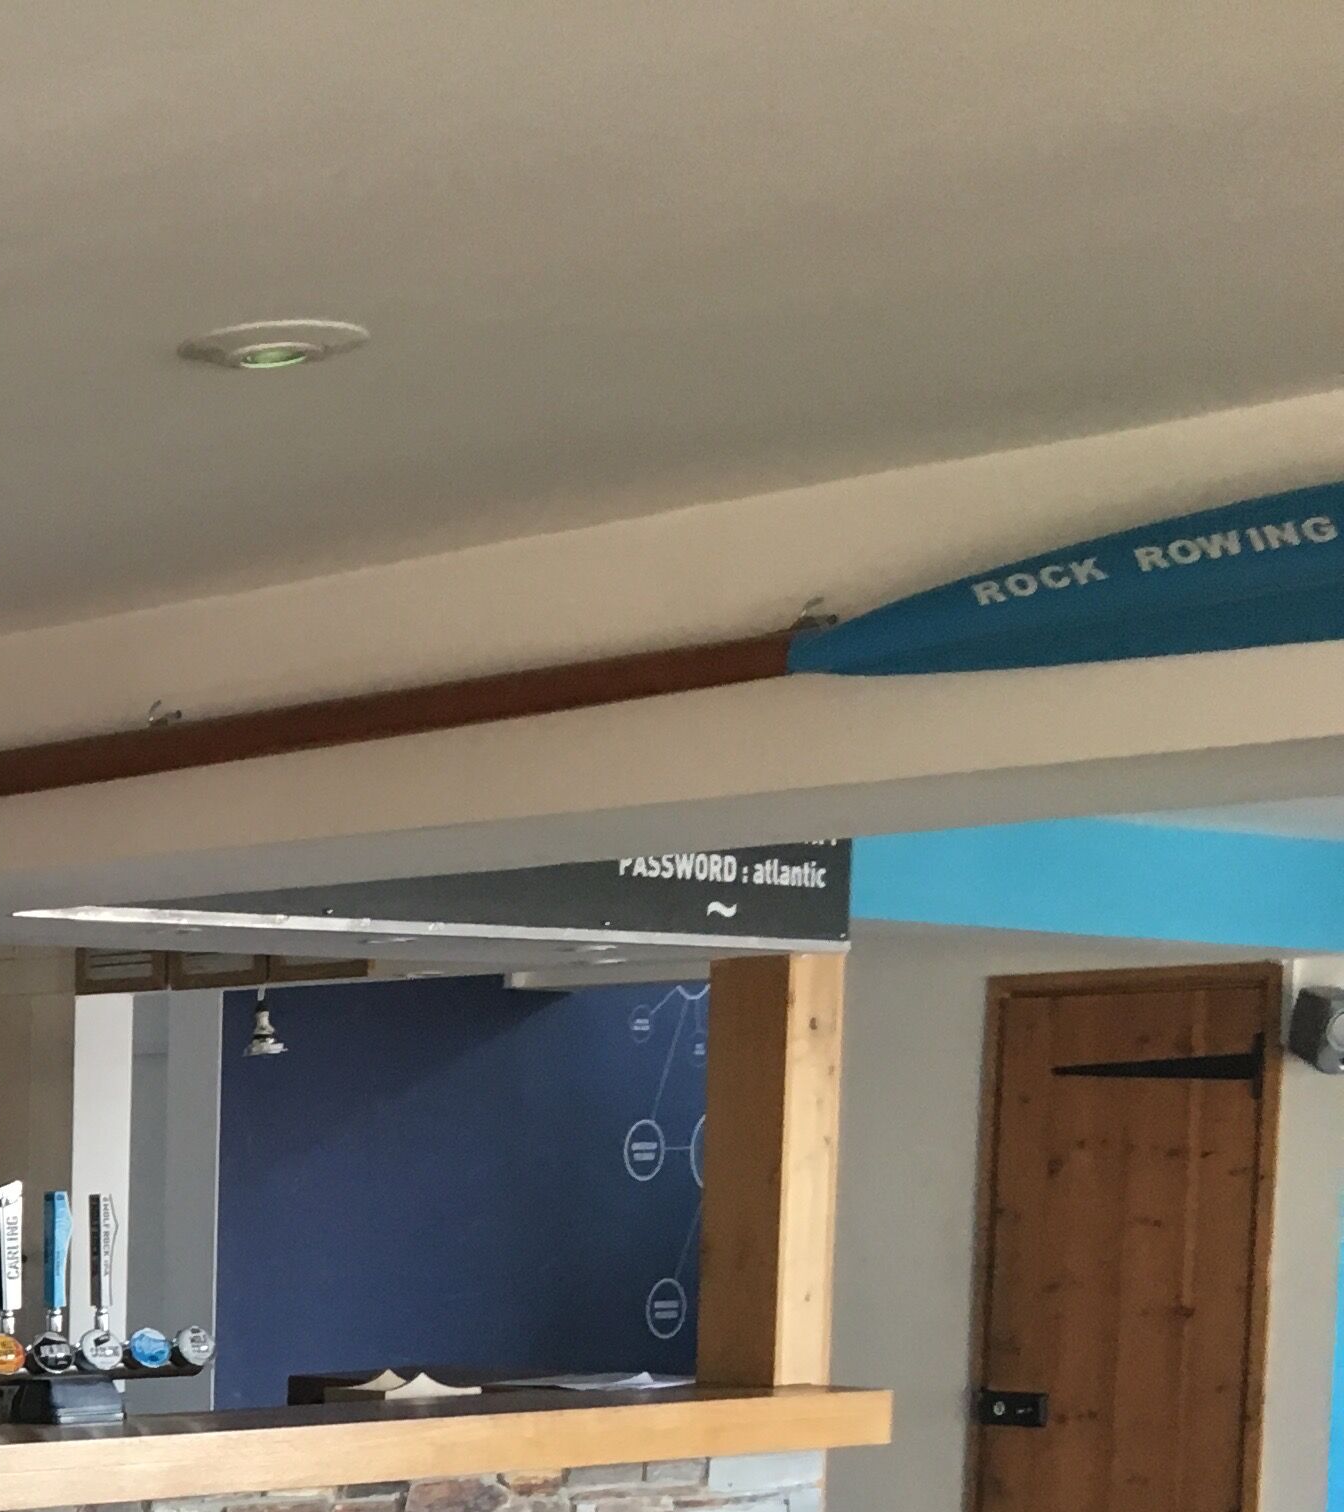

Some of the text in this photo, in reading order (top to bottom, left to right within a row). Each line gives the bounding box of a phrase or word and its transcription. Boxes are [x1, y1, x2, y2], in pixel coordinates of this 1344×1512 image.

[970, 516, 1339, 607] ROCK ROWING
[618, 852, 737, 883] PASSWORD
[752, 858, 827, 889] atlantic
[6, 1215, 21, 1280] CARLING
